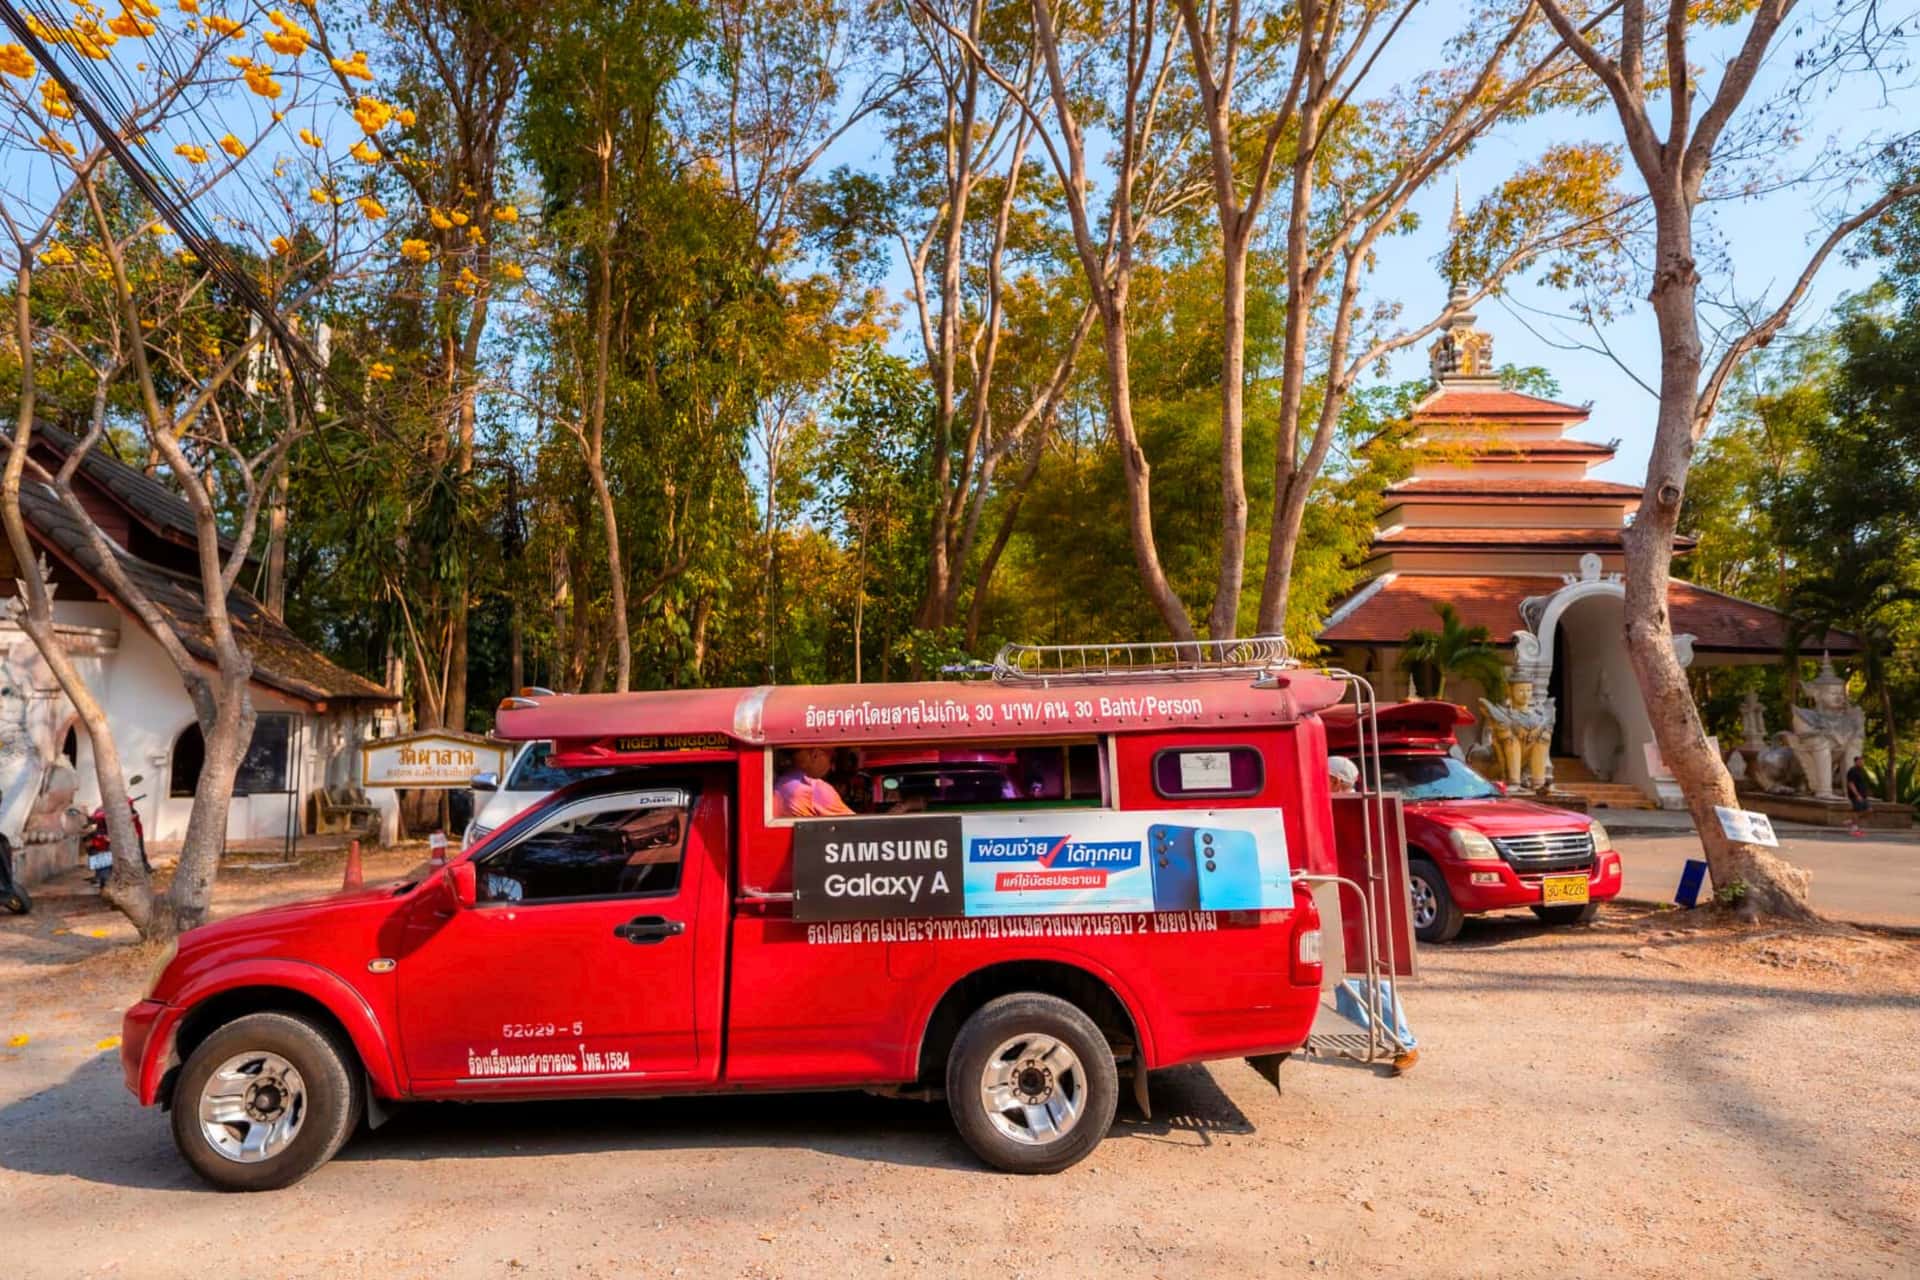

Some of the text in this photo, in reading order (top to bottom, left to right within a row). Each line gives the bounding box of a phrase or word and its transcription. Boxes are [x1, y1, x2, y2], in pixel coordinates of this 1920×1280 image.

[975, 704, 995, 721] 30
[1001, 701, 1070, 721] บาท/คน
[1074, 700, 1093, 719] 30
[1100, 695, 1203, 719] Baht/Person
[618, 733, 730, 750] TIGER KINGDOM
[824, 838, 949, 864] SAMSUNG
[977, 837, 1133, 867] ผ่อนง่าย ได้ทุกคน
[824, 870, 950, 903] Galaxy A
[1137, 915, 1147, 934] 2
